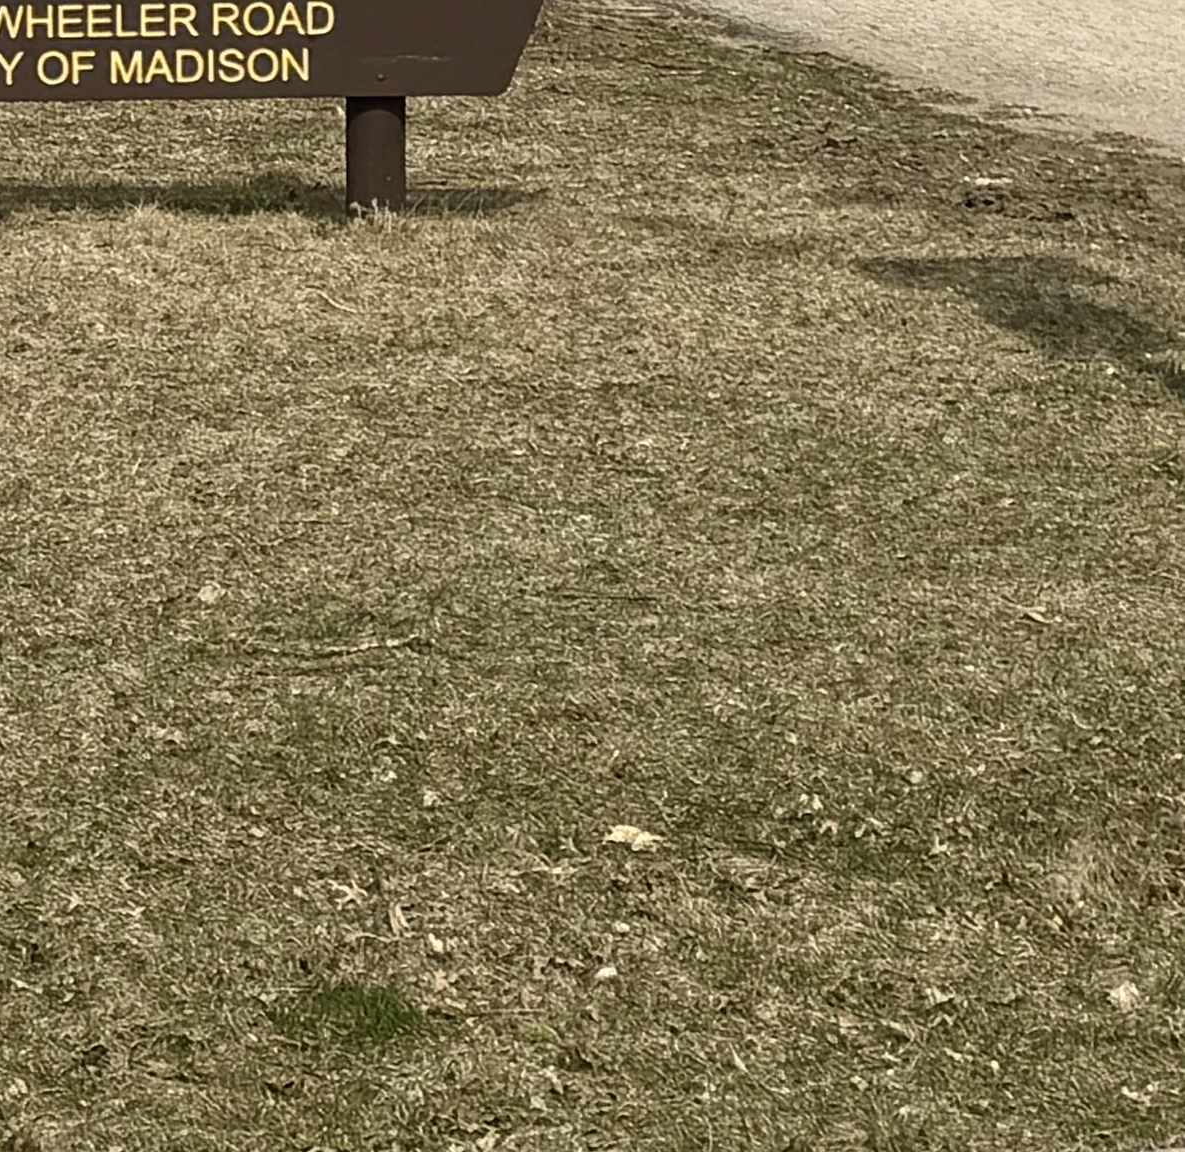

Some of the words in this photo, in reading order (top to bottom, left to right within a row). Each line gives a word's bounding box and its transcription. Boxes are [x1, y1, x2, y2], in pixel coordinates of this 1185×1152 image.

[212, 0, 335, 37] ROAD
[36, 50, 96, 86] OF
[110, 47, 310, 85] MADISON
